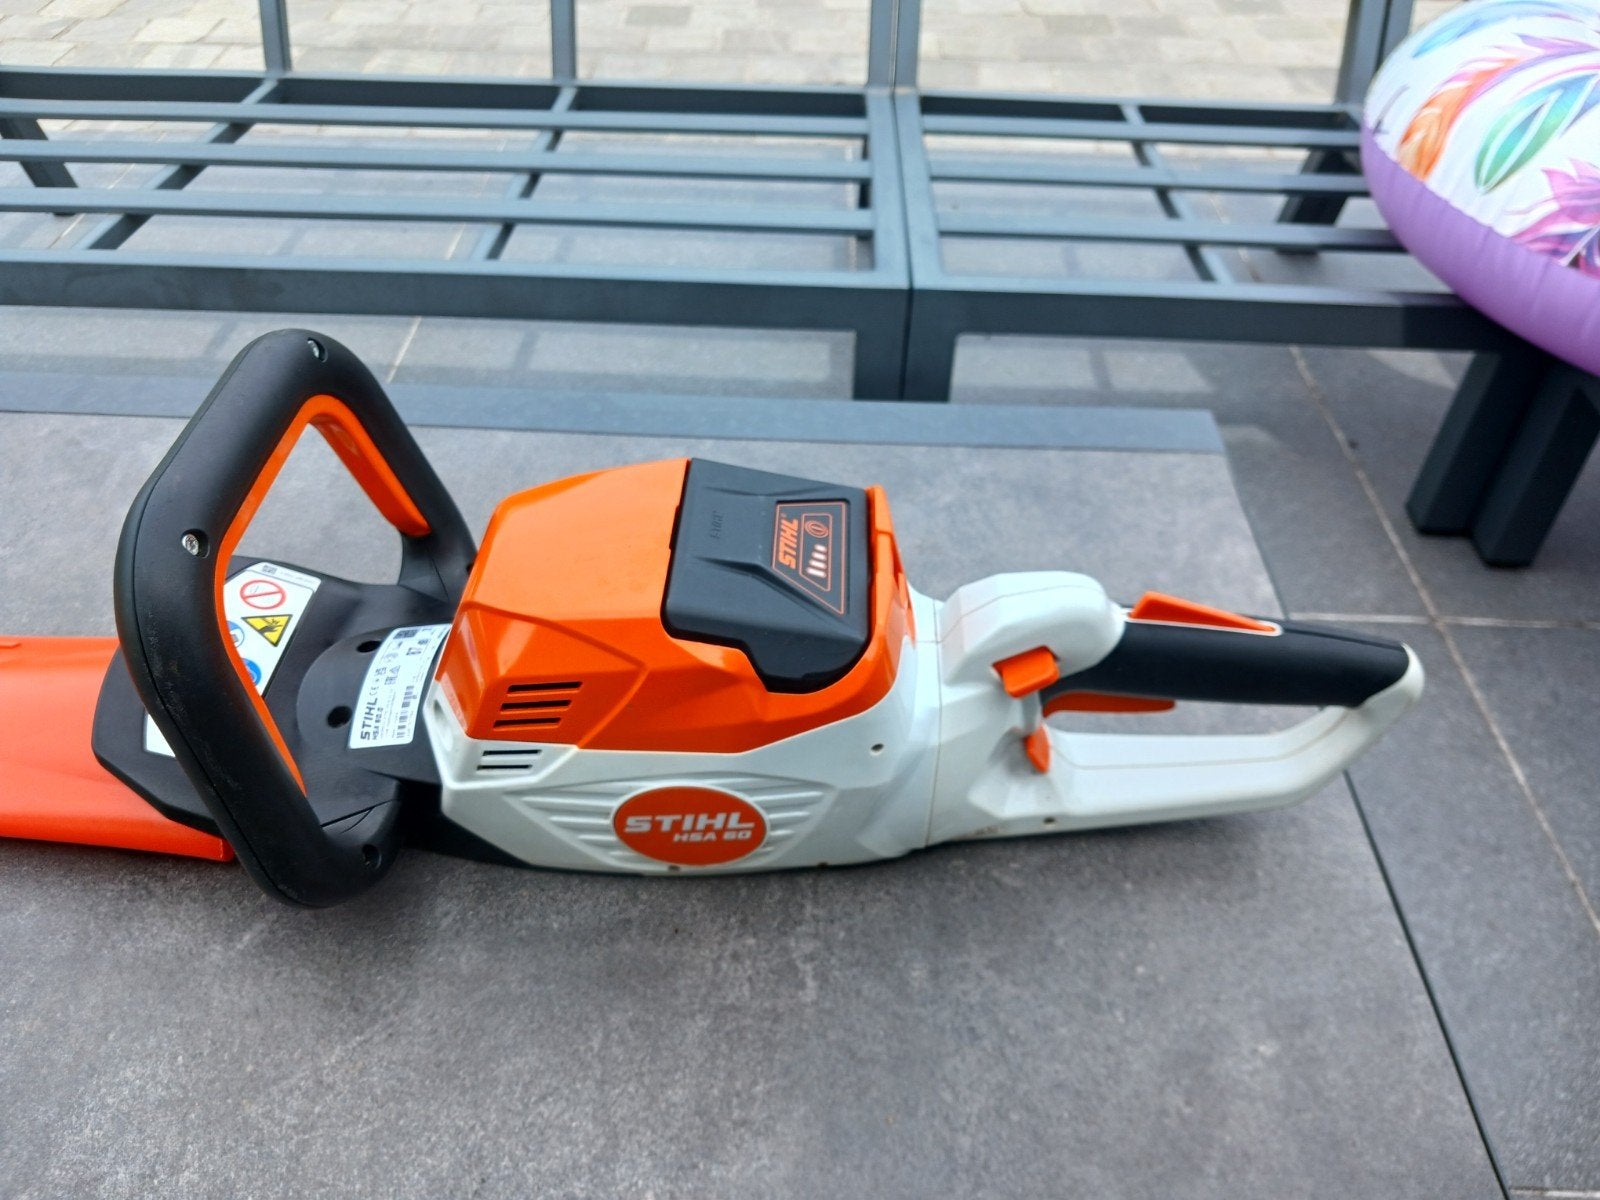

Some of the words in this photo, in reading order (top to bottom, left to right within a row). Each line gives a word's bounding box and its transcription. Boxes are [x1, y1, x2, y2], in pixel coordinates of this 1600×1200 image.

[778, 518, 799, 570] STIHL
[360, 697, 378, 741] STIHL
[624, 812, 756, 834] STIHL
[673, 831, 717, 843] HSA
